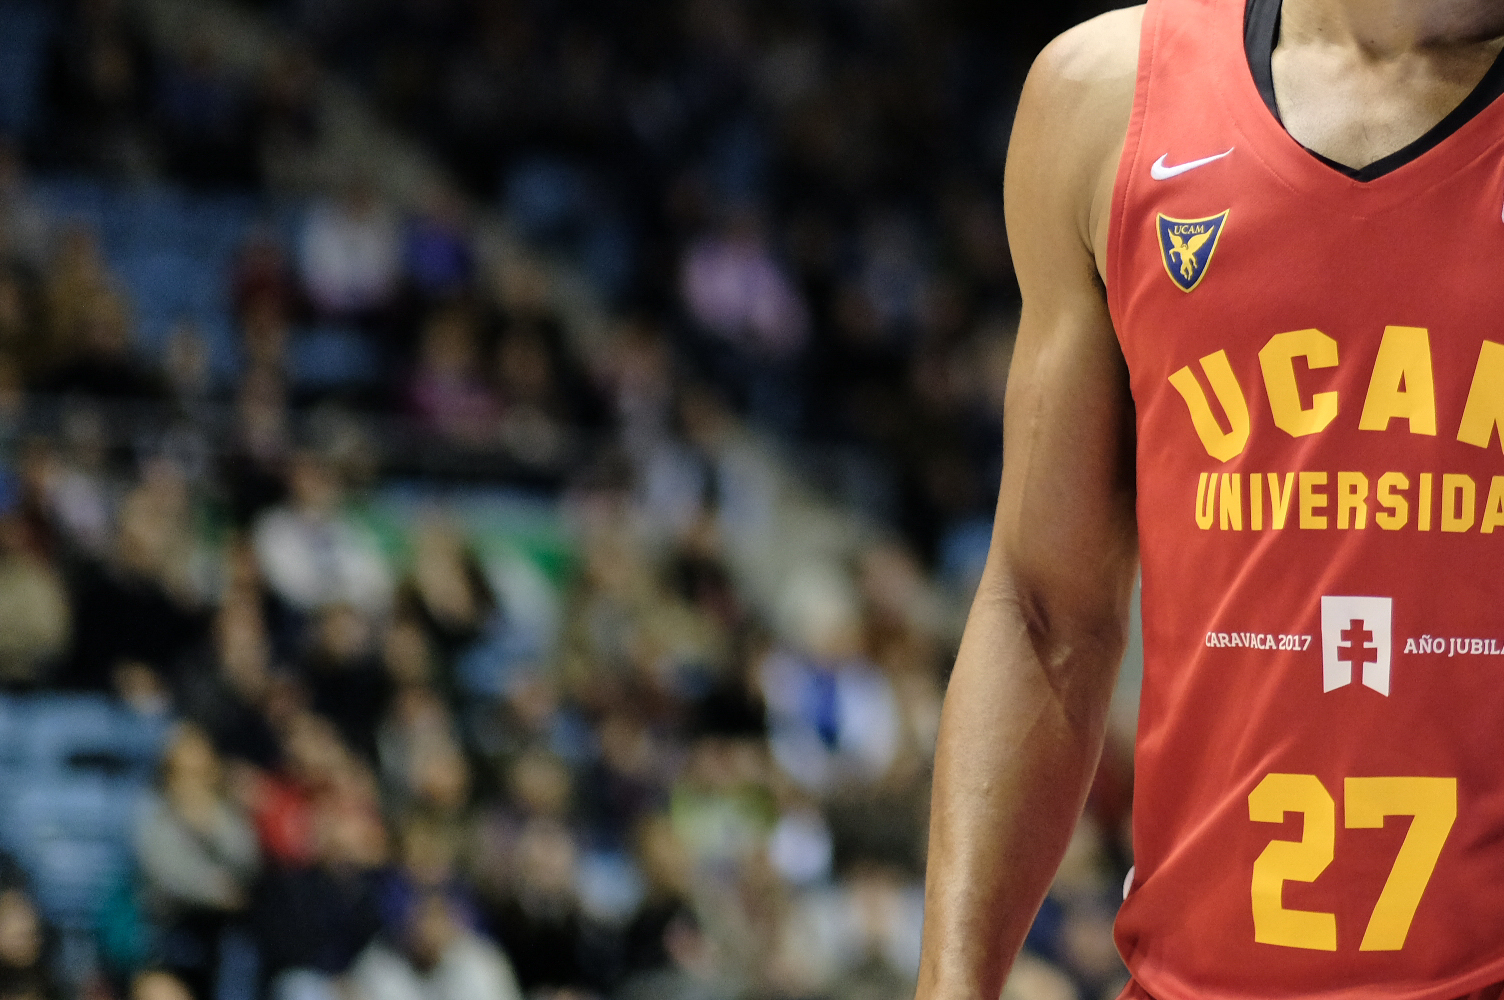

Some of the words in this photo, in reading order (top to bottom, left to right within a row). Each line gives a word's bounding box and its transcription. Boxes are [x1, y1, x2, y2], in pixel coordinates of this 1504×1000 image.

[1173, 225, 1205, 235] UCAM
[1205, 631, 1277, 650] CARAVACA
[1278, 634, 1312, 651] 2017
[1403, 633, 1446, 654] AÑO
[1248, 773, 1457, 951] 27
